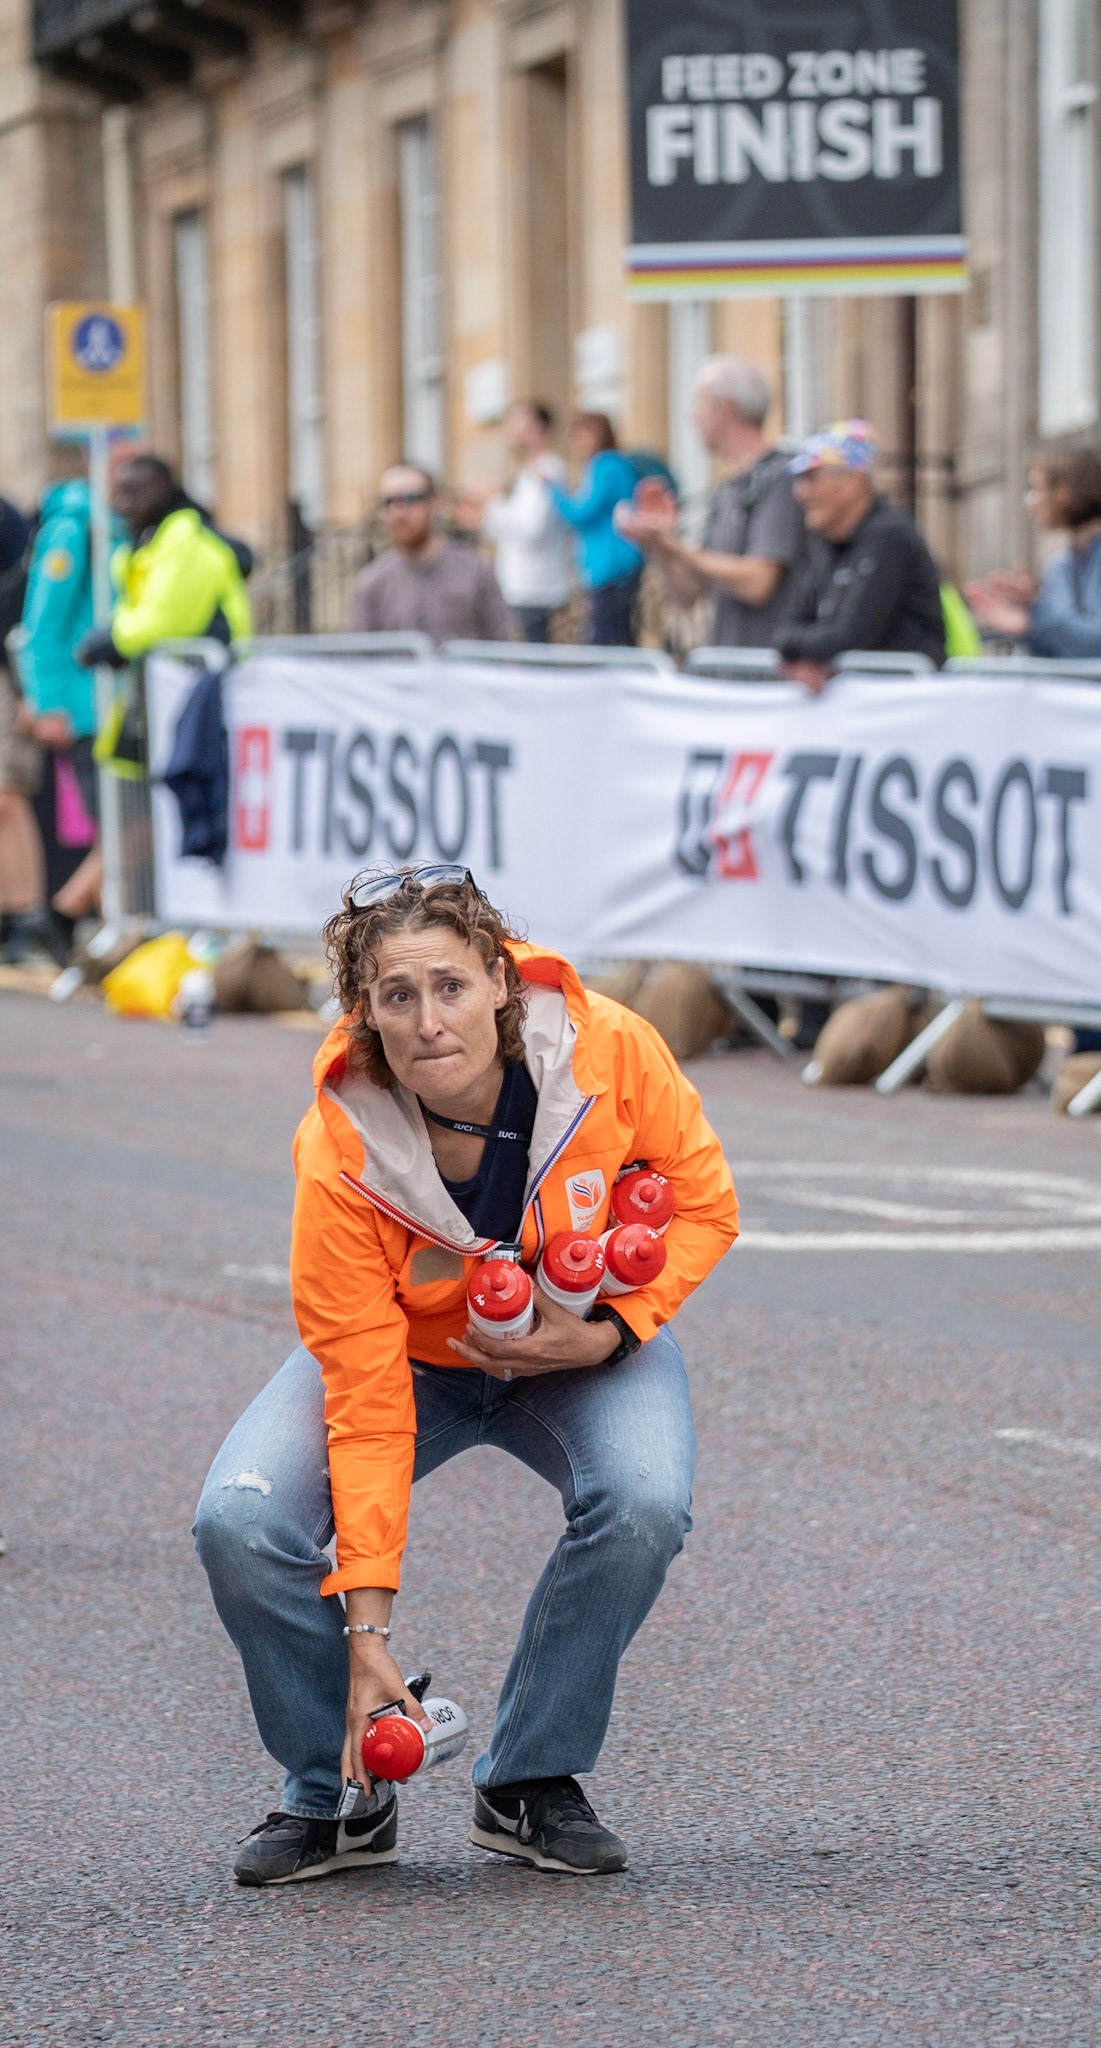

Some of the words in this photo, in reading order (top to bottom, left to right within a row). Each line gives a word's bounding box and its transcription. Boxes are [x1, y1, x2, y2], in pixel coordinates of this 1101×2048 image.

[661, 52, 784, 100] FEED
[787, 48, 926, 97] ZONE
[645, 97, 943, 186] FINISH
[283, 728, 512, 872] TISSOT
[779, 752, 1086, 914] TISSOT
[501, 1131, 518, 1140] UCI
